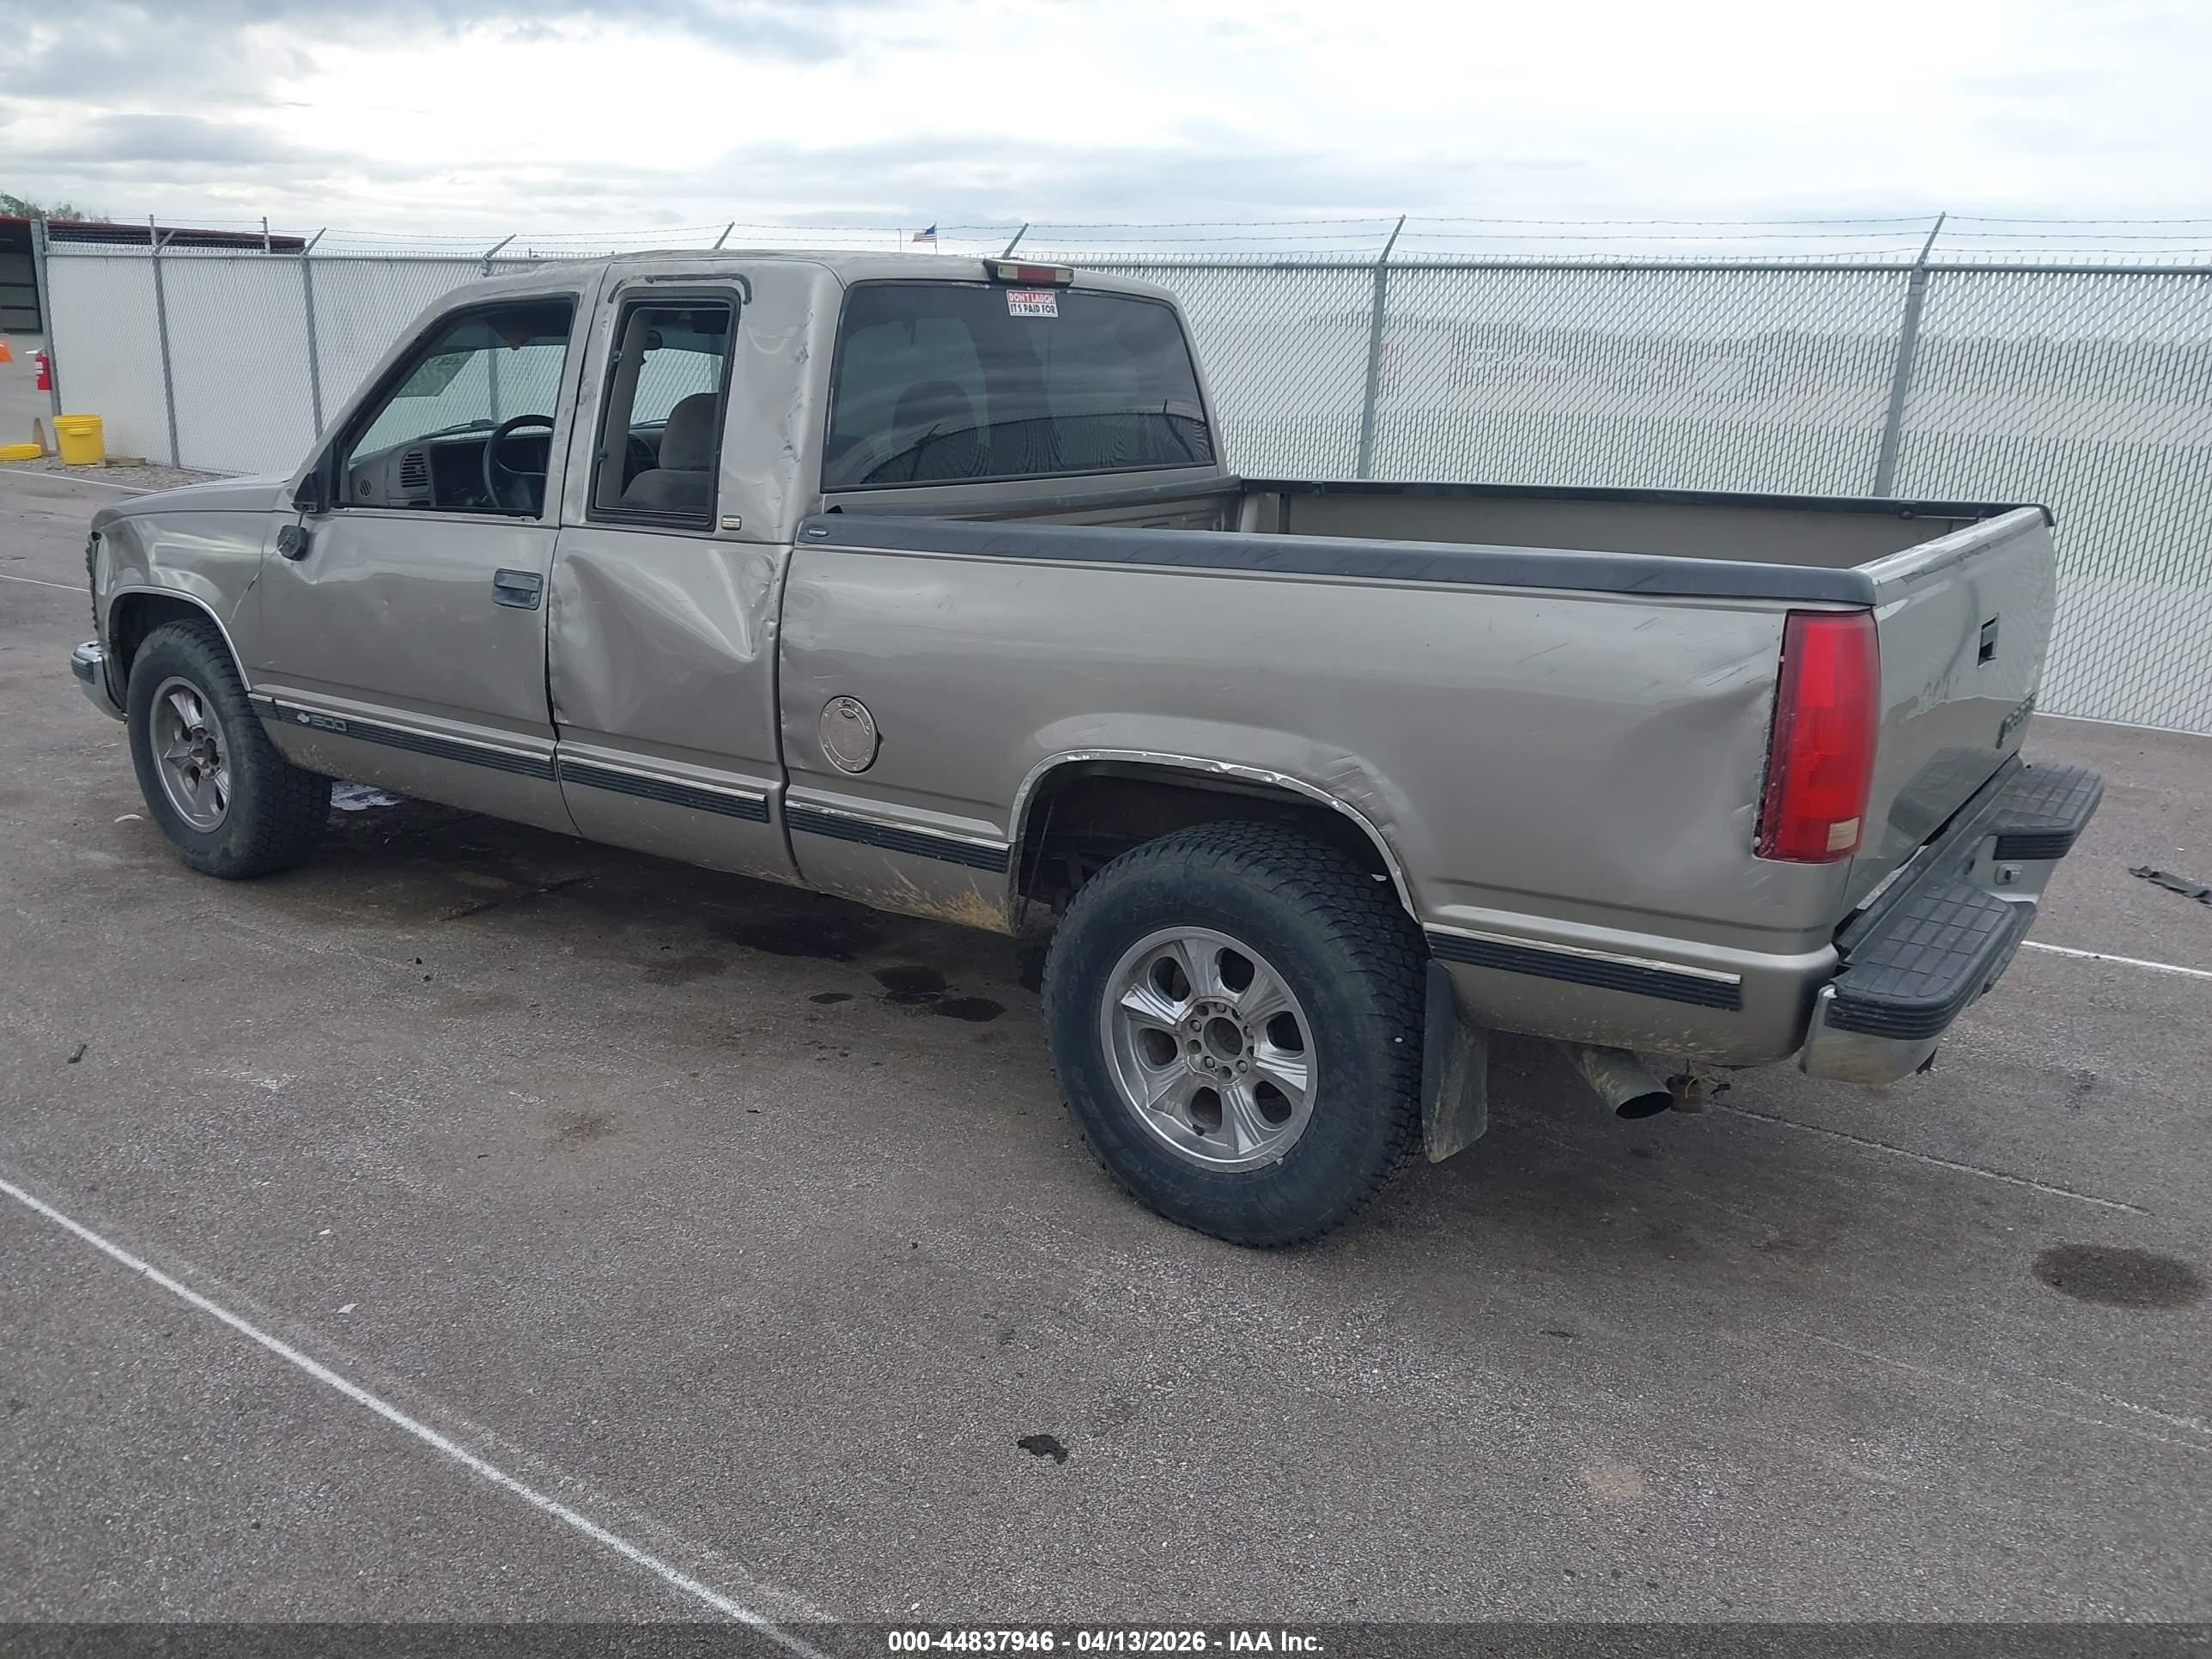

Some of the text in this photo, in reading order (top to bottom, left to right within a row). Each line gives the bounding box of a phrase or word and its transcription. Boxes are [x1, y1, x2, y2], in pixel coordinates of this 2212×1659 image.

[1030, 293, 1054, 304] LAUGH
[1023, 304, 1040, 313] PAID
[1041, 305, 1056, 314] FOR
